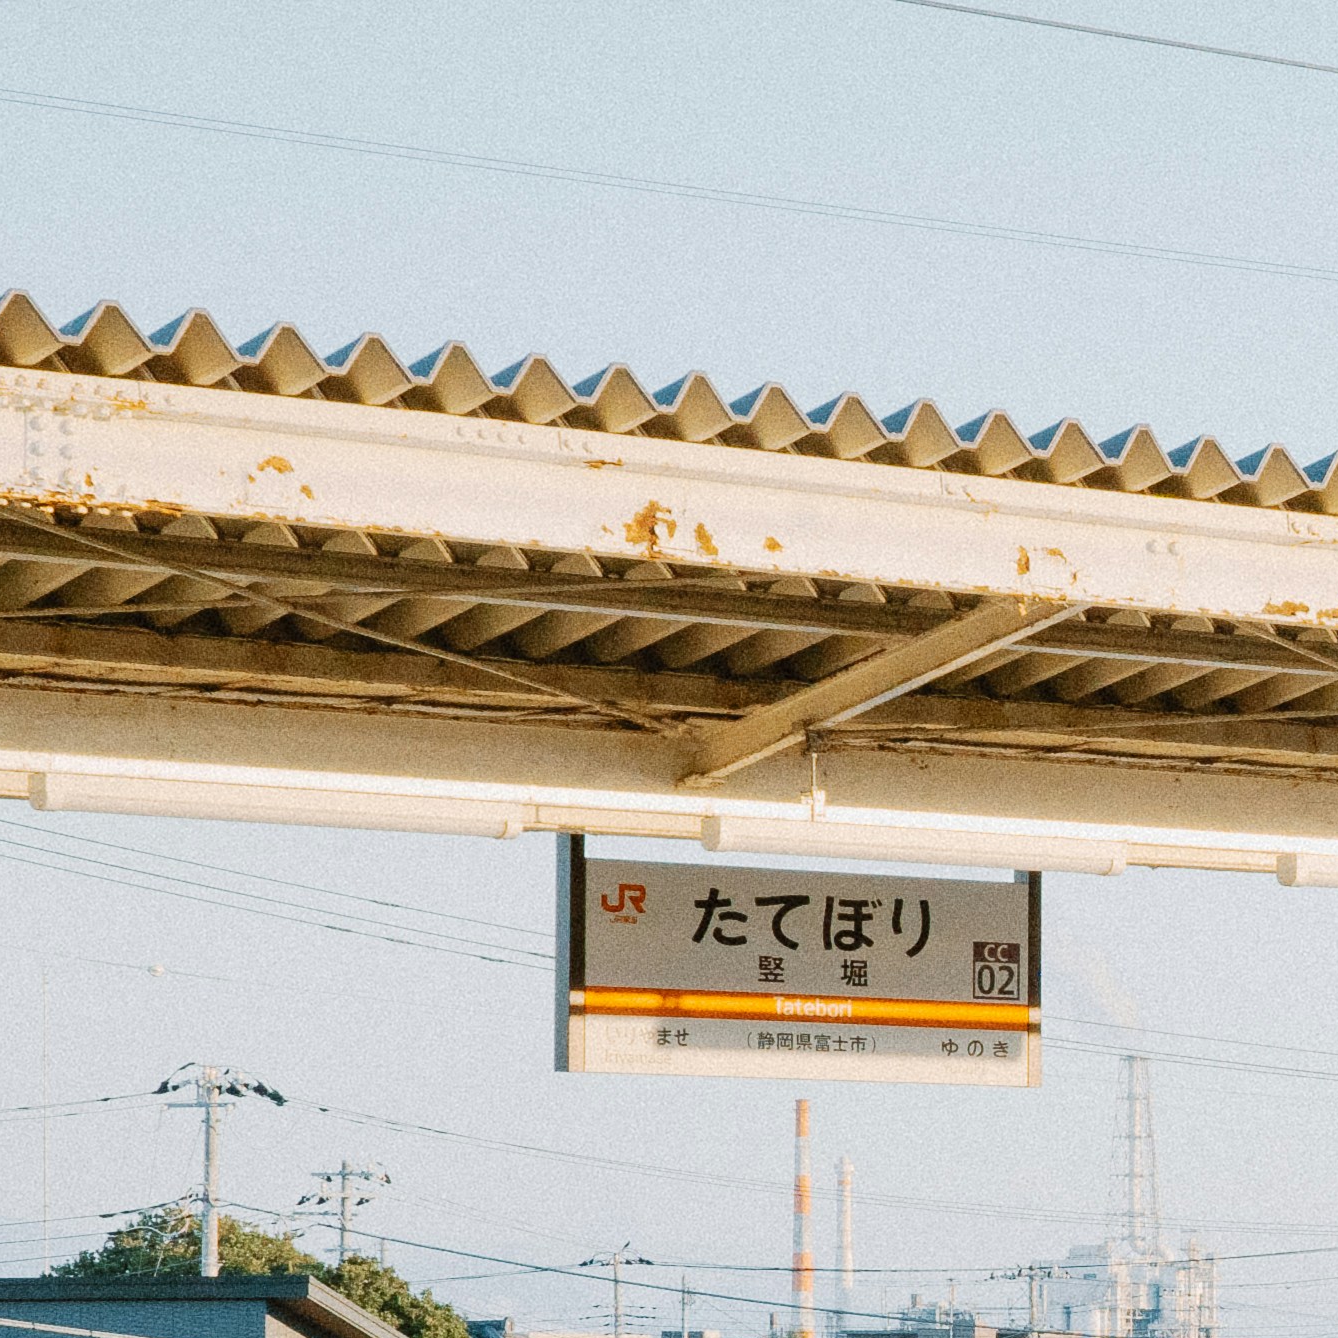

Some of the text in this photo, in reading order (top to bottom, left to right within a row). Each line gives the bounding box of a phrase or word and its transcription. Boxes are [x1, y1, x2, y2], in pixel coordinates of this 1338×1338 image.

[601, 883, 646, 914] JR
[691, 886, 933, 958] たてぼり
[983, 944, 1009, 962] CC
[976, 964, 1016, 996] 02
[773, 996, 853, 1018] Tatebori
[942, 1038, 1009, 1058] ゆのき
